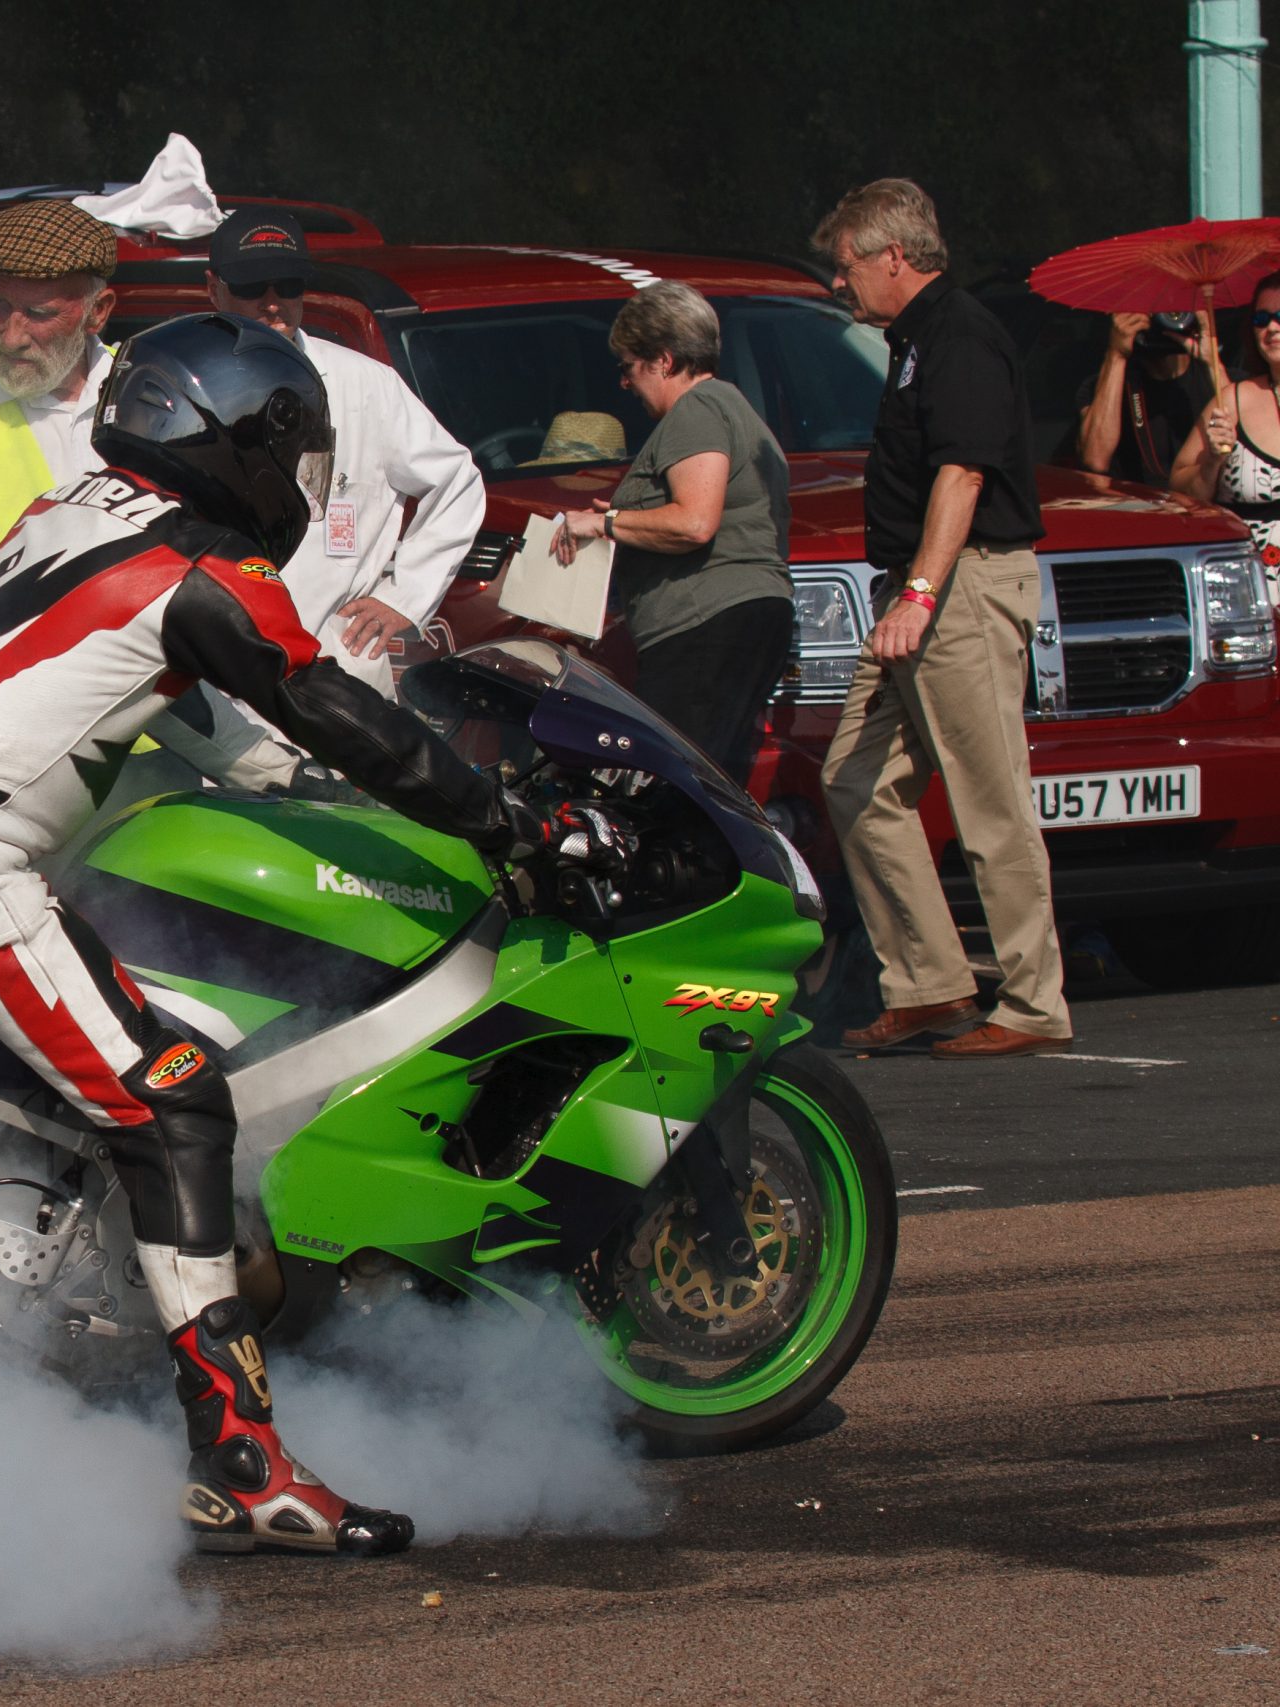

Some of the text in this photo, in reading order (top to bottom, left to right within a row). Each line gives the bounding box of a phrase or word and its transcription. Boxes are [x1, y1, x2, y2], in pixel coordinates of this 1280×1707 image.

[1133, 393, 1144, 428] Canon
[1031, 773, 1186, 821] U57 YMH
[315, 863, 454, 914] Kawasaki
[662, 983, 780, 1019] ZX-9R
[150, 1047, 199, 1086] SCOTT
